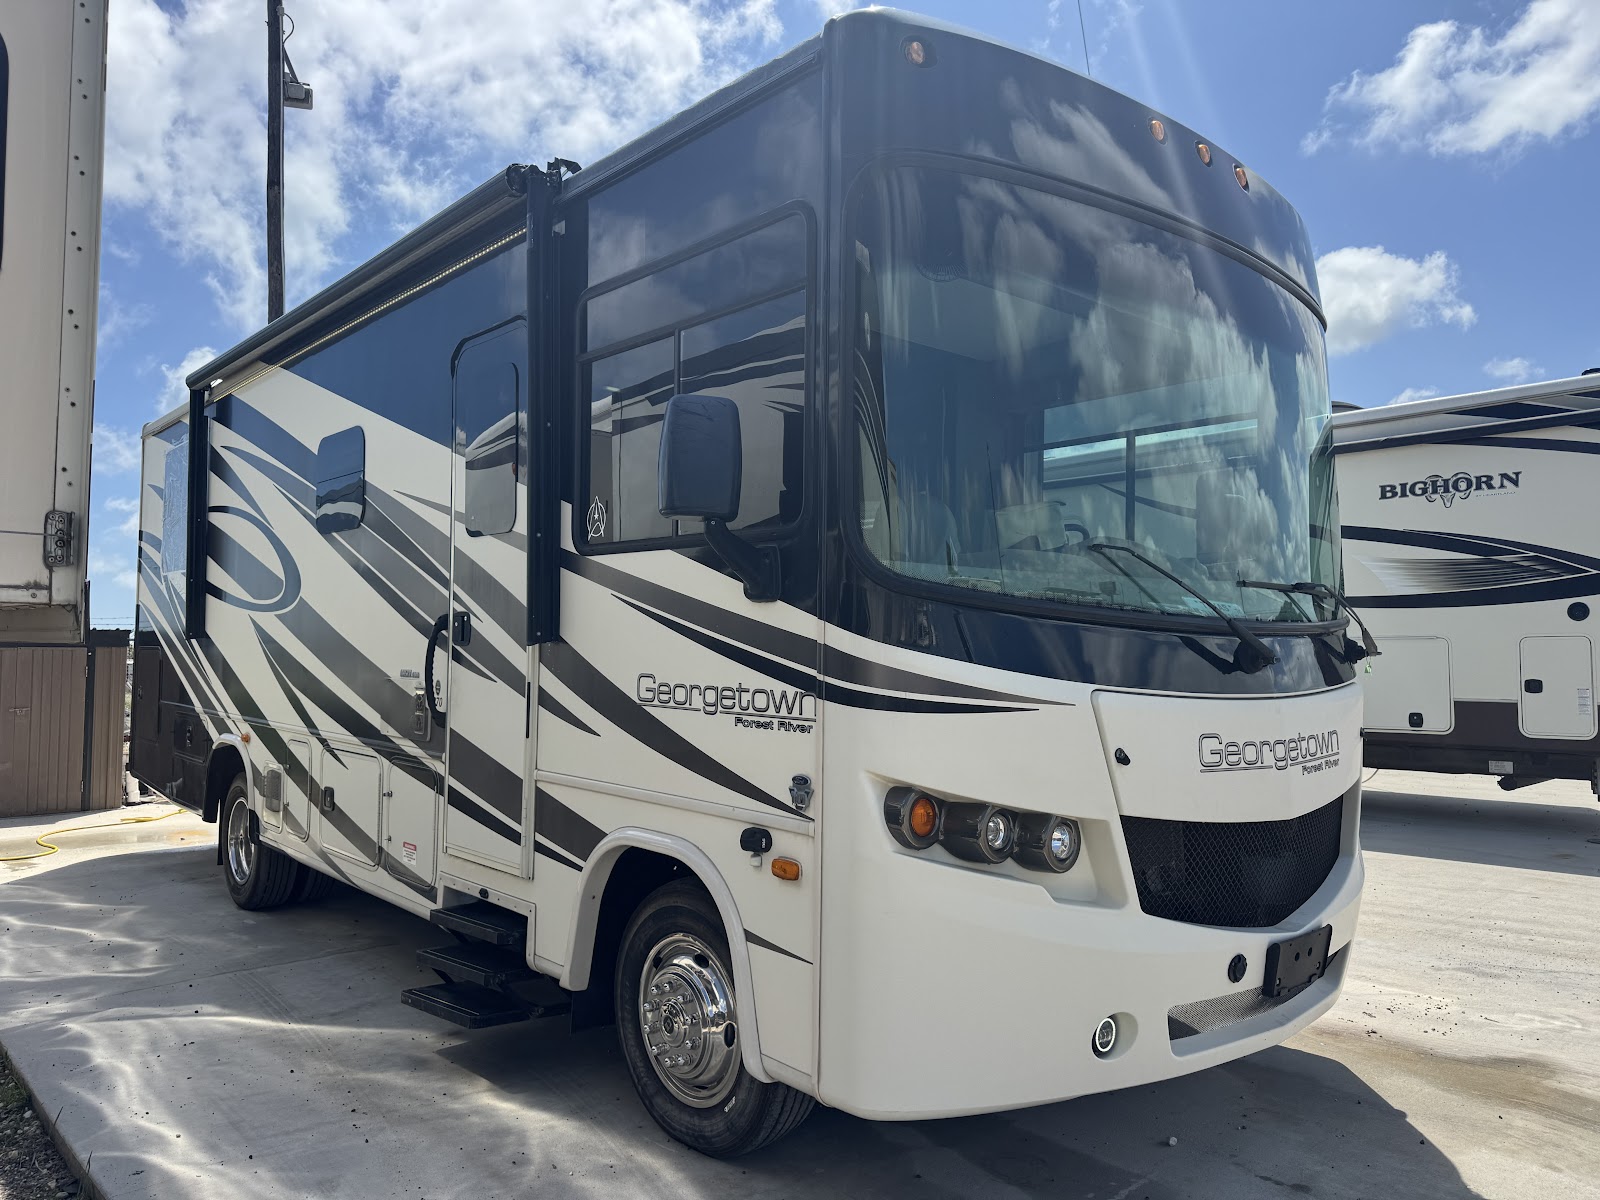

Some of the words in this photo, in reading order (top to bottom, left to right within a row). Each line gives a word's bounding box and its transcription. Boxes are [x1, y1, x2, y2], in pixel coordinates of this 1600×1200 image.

[1379, 471, 1522, 500] BIGHORN
[637, 673, 817, 716] Georgetown
[735, 717, 774, 730] Forest
[778, 721, 814, 733] River
[1199, 730, 1340, 770] Georgetown
[1302, 762, 1323, 775] Forest
[1324, 759, 1339, 769] River
